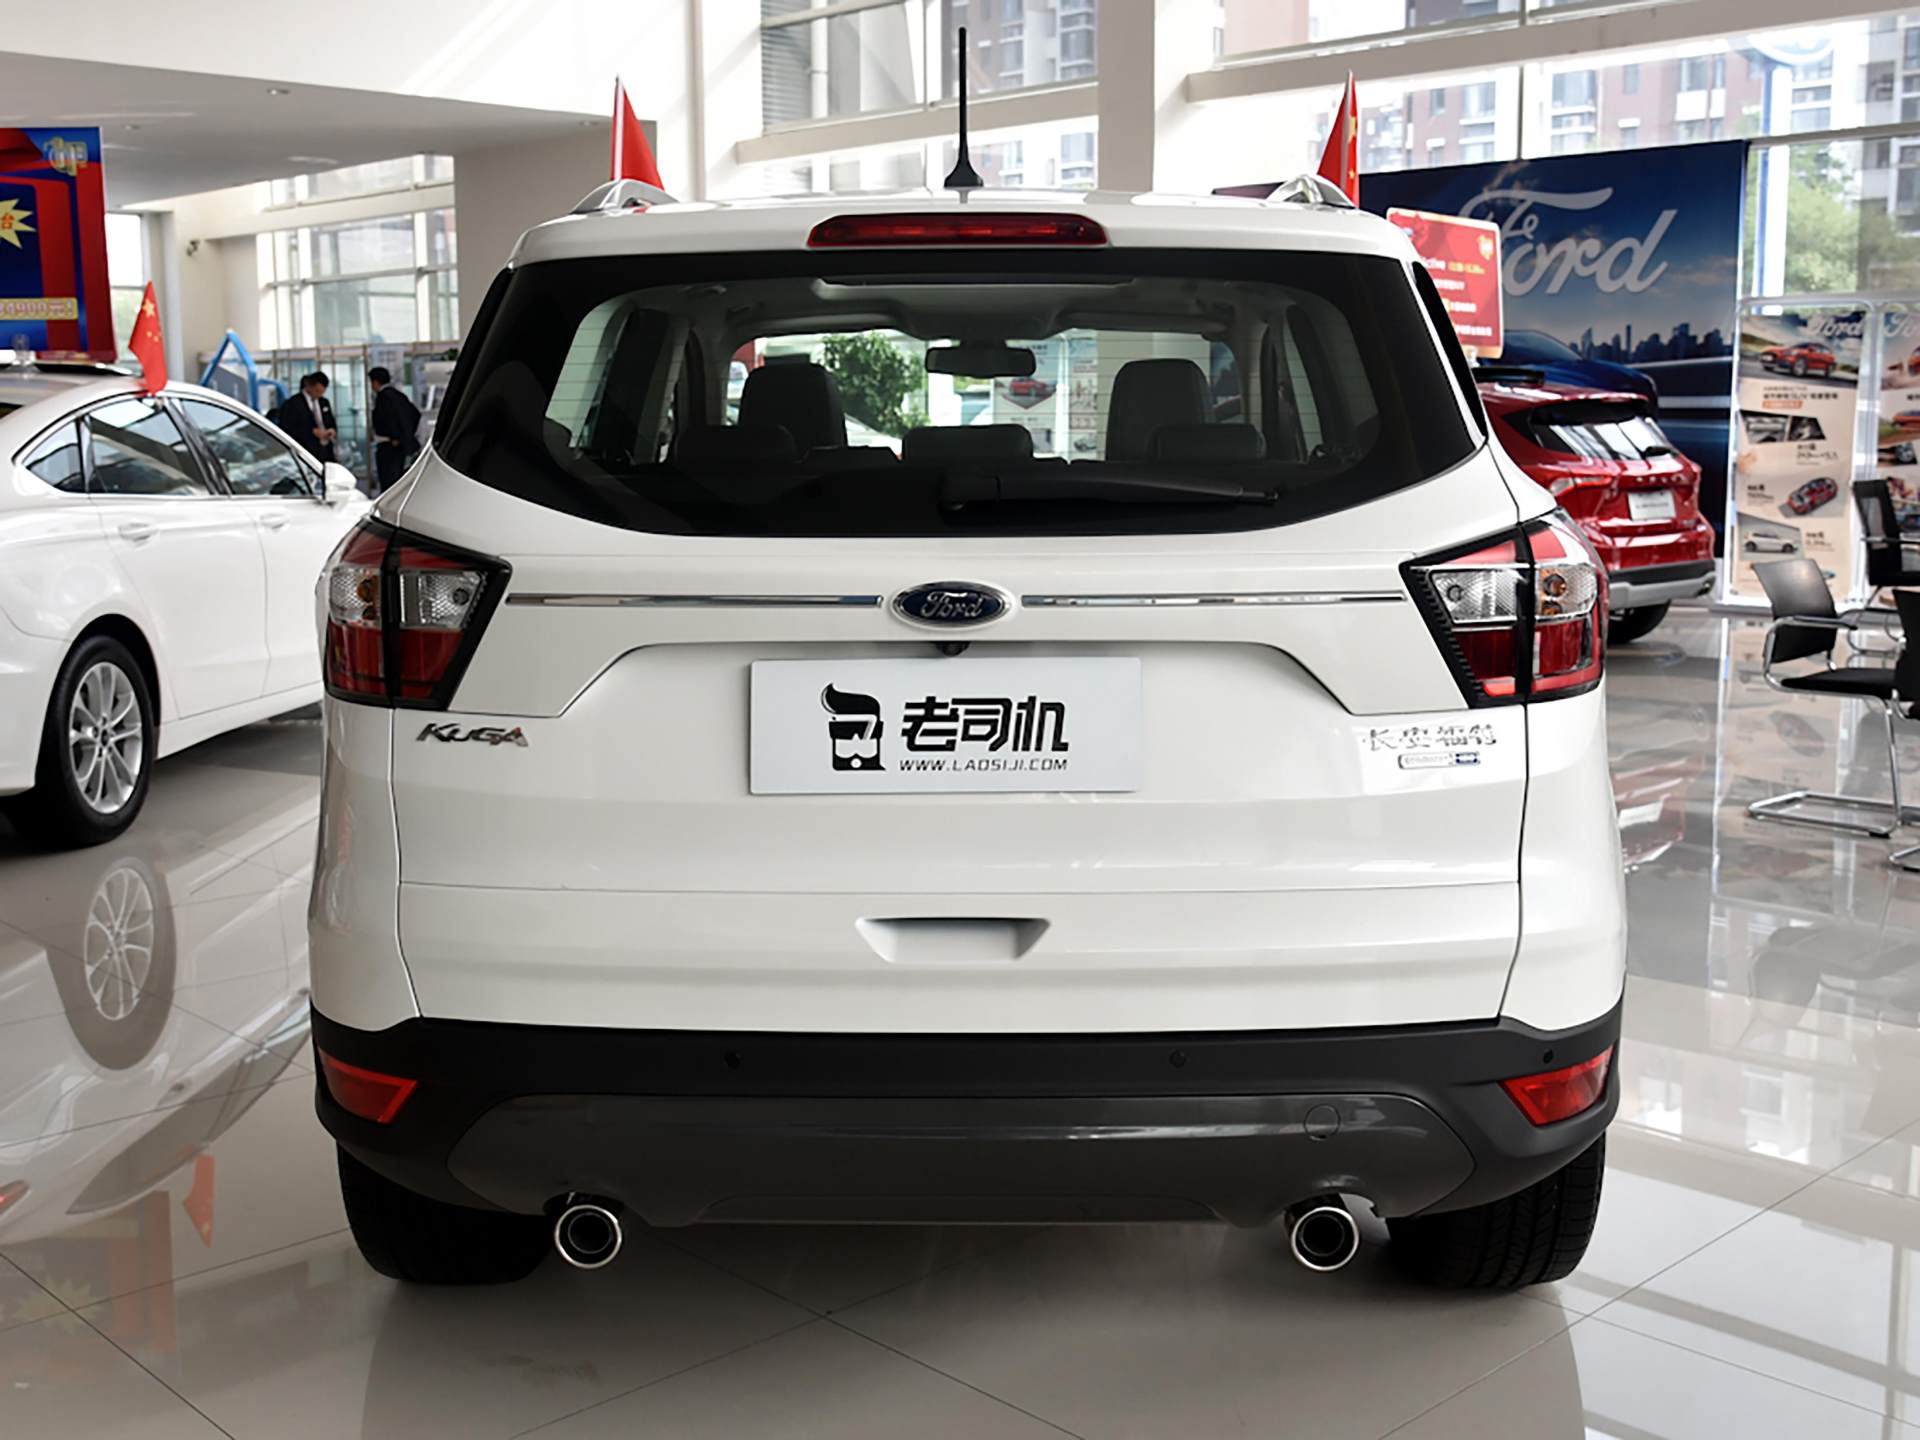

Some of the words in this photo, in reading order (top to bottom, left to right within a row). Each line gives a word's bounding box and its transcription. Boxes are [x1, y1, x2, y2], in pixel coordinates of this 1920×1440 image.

[1459, 187, 1678, 296] Ford
[921, 591, 982, 617] Ford
[416, 722, 529, 748] KUGA
[901, 695, 1069, 752] 老司机
[899, 758, 1068, 772] WWW.LAOSIJI.COM
